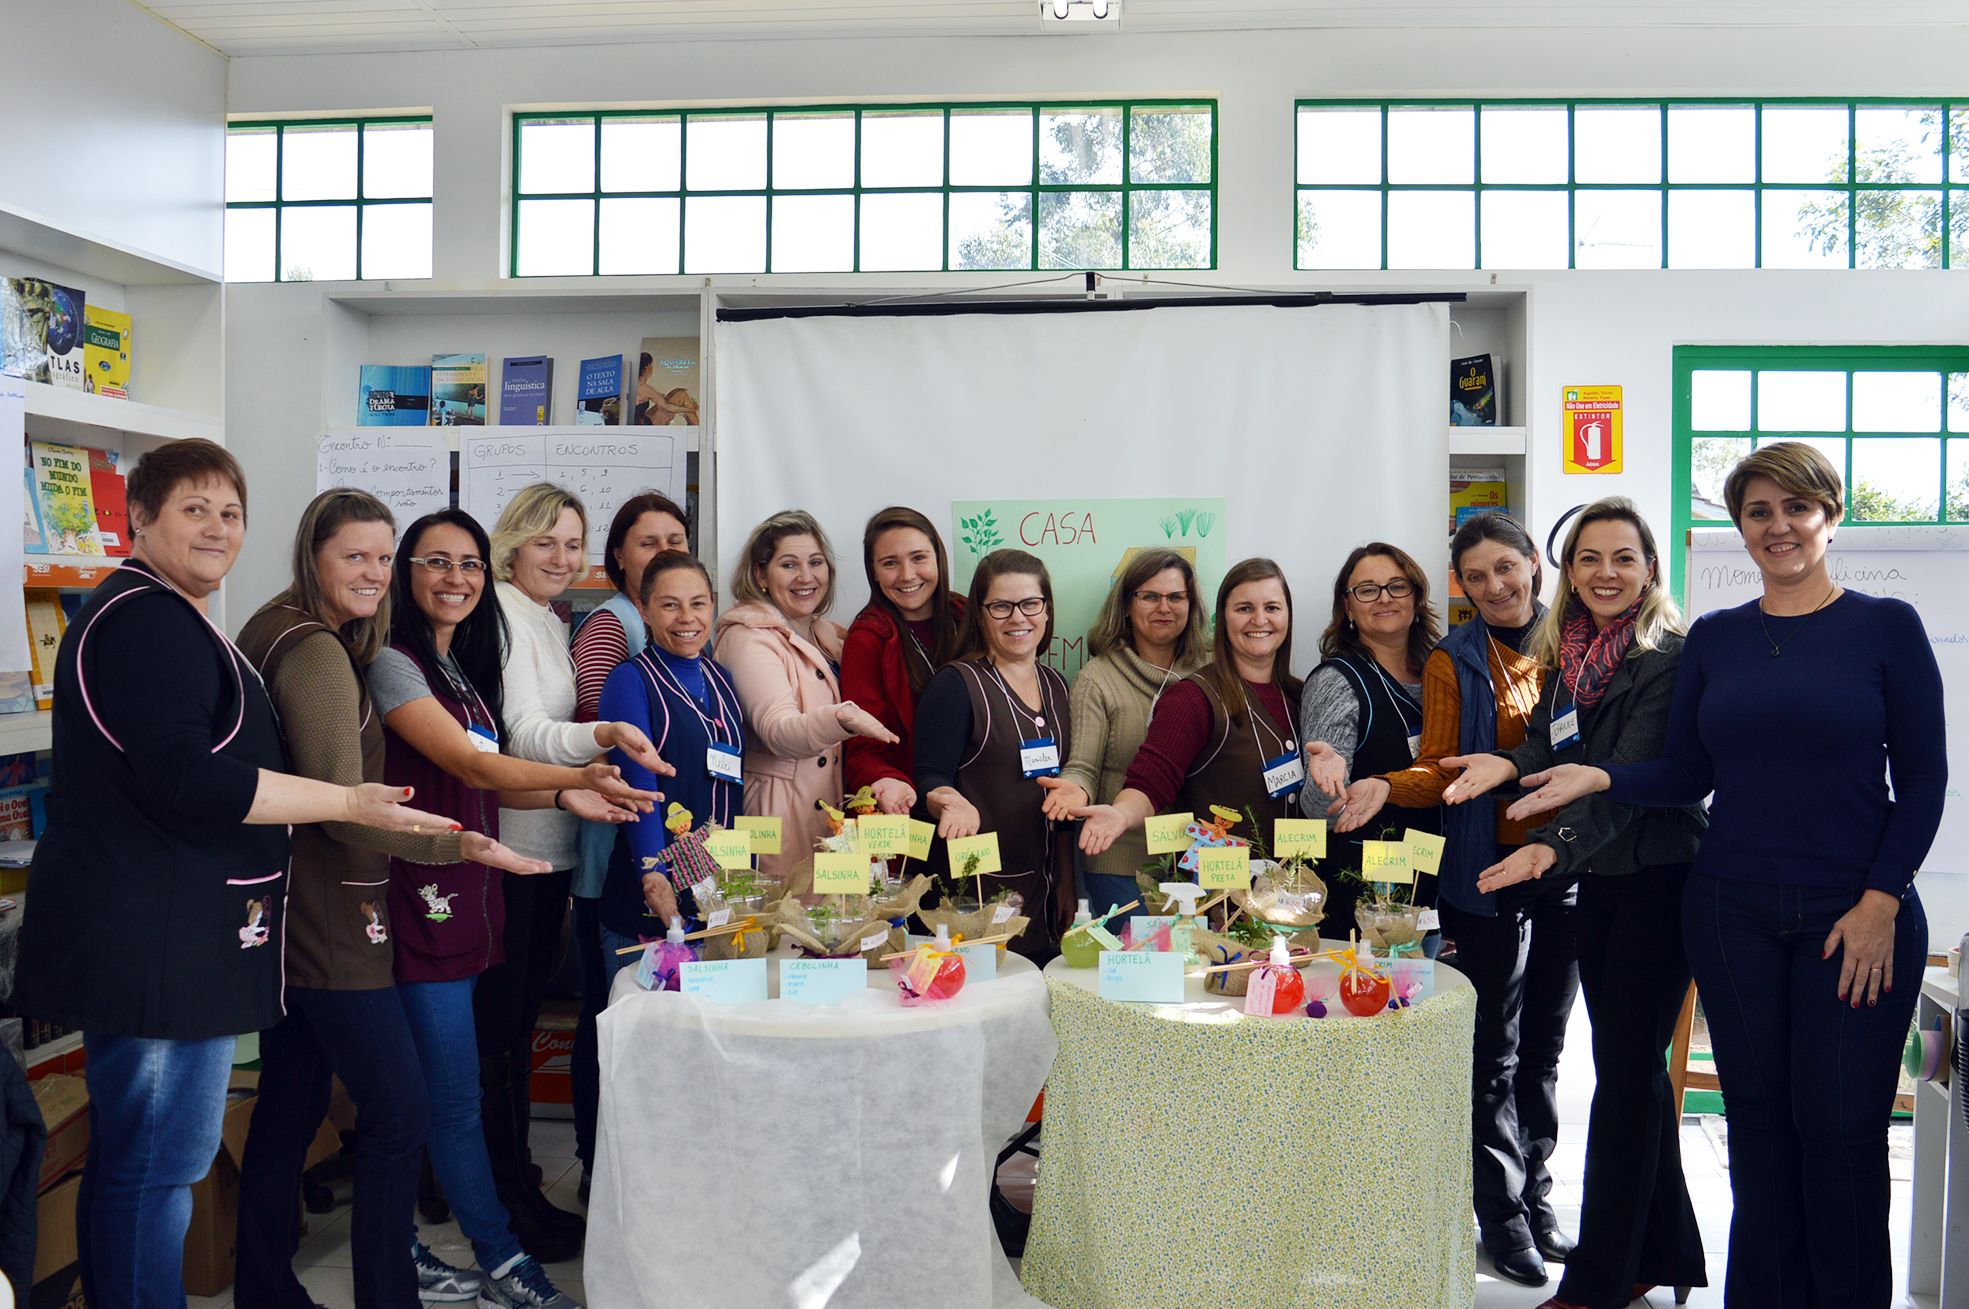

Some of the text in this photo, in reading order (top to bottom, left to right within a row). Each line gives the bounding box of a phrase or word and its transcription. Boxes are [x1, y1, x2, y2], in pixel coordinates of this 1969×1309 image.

[91, 332, 119, 349] GEOGRAFIA
[593, 370, 616, 379] TEXTO
[1470, 367, 1476, 377] O
[504, 380, 545, 393] linguística
[1459, 373, 1487, 389] Guarani
[596, 385, 614, 394] AULA
[1593, 401, 1619, 409] Eletricidade
[473, 443, 638, 460] GRUPOS ENCONTROS
[54, 457, 69, 469] FIM
[71, 460, 82, 472] DO
[48, 471, 78, 483] MUNDO
[72, 486, 87, 497] FIM
[1489, 490, 1499, 500] Os
[1019, 511, 1096, 546] CASA
[1700, 564, 1762, 589] Mome
[864, 823, 906, 839] HORTELÃ
[868, 840, 892, 849] VERDE
[955, 847, 990, 862] ORÉANO
[815, 869, 860, 880] SALSINHA
[1210, 873, 1235, 883] PRETA
[1107, 953, 1151, 965] HORTELÃ
[688, 962, 728, 973] SALSINHA
[789, 962, 839, 970] CEBOLINHA
